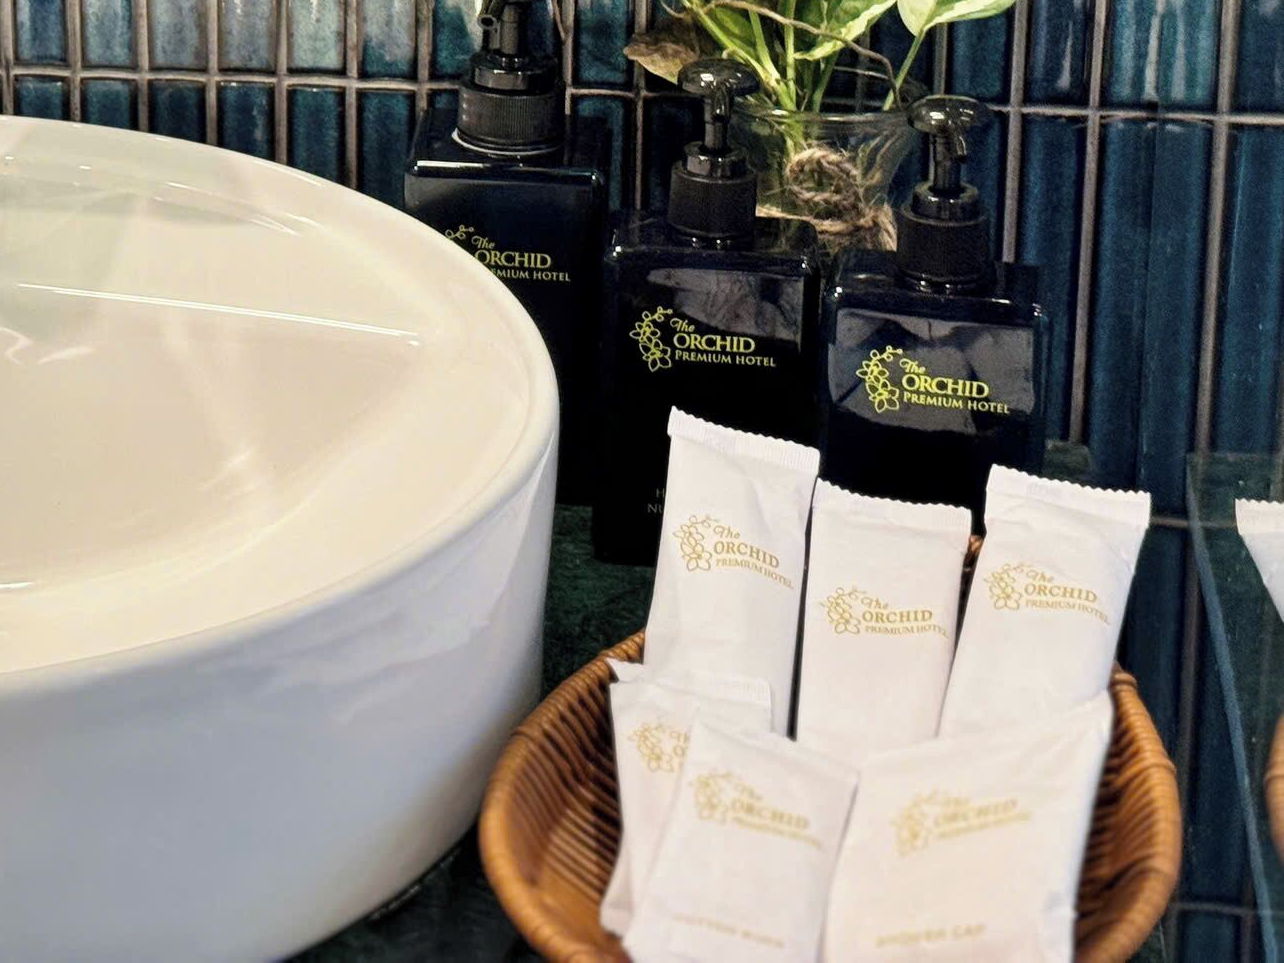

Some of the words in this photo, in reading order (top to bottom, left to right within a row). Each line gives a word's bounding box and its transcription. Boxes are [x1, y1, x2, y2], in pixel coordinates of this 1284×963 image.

[471, 236, 496, 250] The
[474, 249, 552, 269] ORCHID
[532, 269, 571, 283] HOTEL
[670, 317, 696, 333] The
[673, 332, 756, 354] ORCHID
[674, 349, 732, 365] PREMIUM
[735, 354, 777, 368] HOTEL
[899, 358, 927, 374] The
[901, 374, 990, 399] ORCHID
[903, 391, 964, 409] PREMIUM
[967, 399, 1010, 415] HOTEL
[713, 524, 741, 539] The
[713, 540, 780, 569] ORCHID
[715, 557, 763, 574] PREMIUM
[763, 568, 795, 590] HOTEL
[1026, 569, 1055, 583] The
[861, 596, 889, 610] The
[1024, 583, 1098, 604] ORCHID
[861, 609, 933, 624] ORCHID
[1025, 599, 1078, 611] PREMIUM
[1077, 603, 1112, 626] HOTEL
[864, 624, 915, 635] PREMIUM
[917, 623, 950, 639] HOTEL
[732, 797, 811, 830] ORCHID
